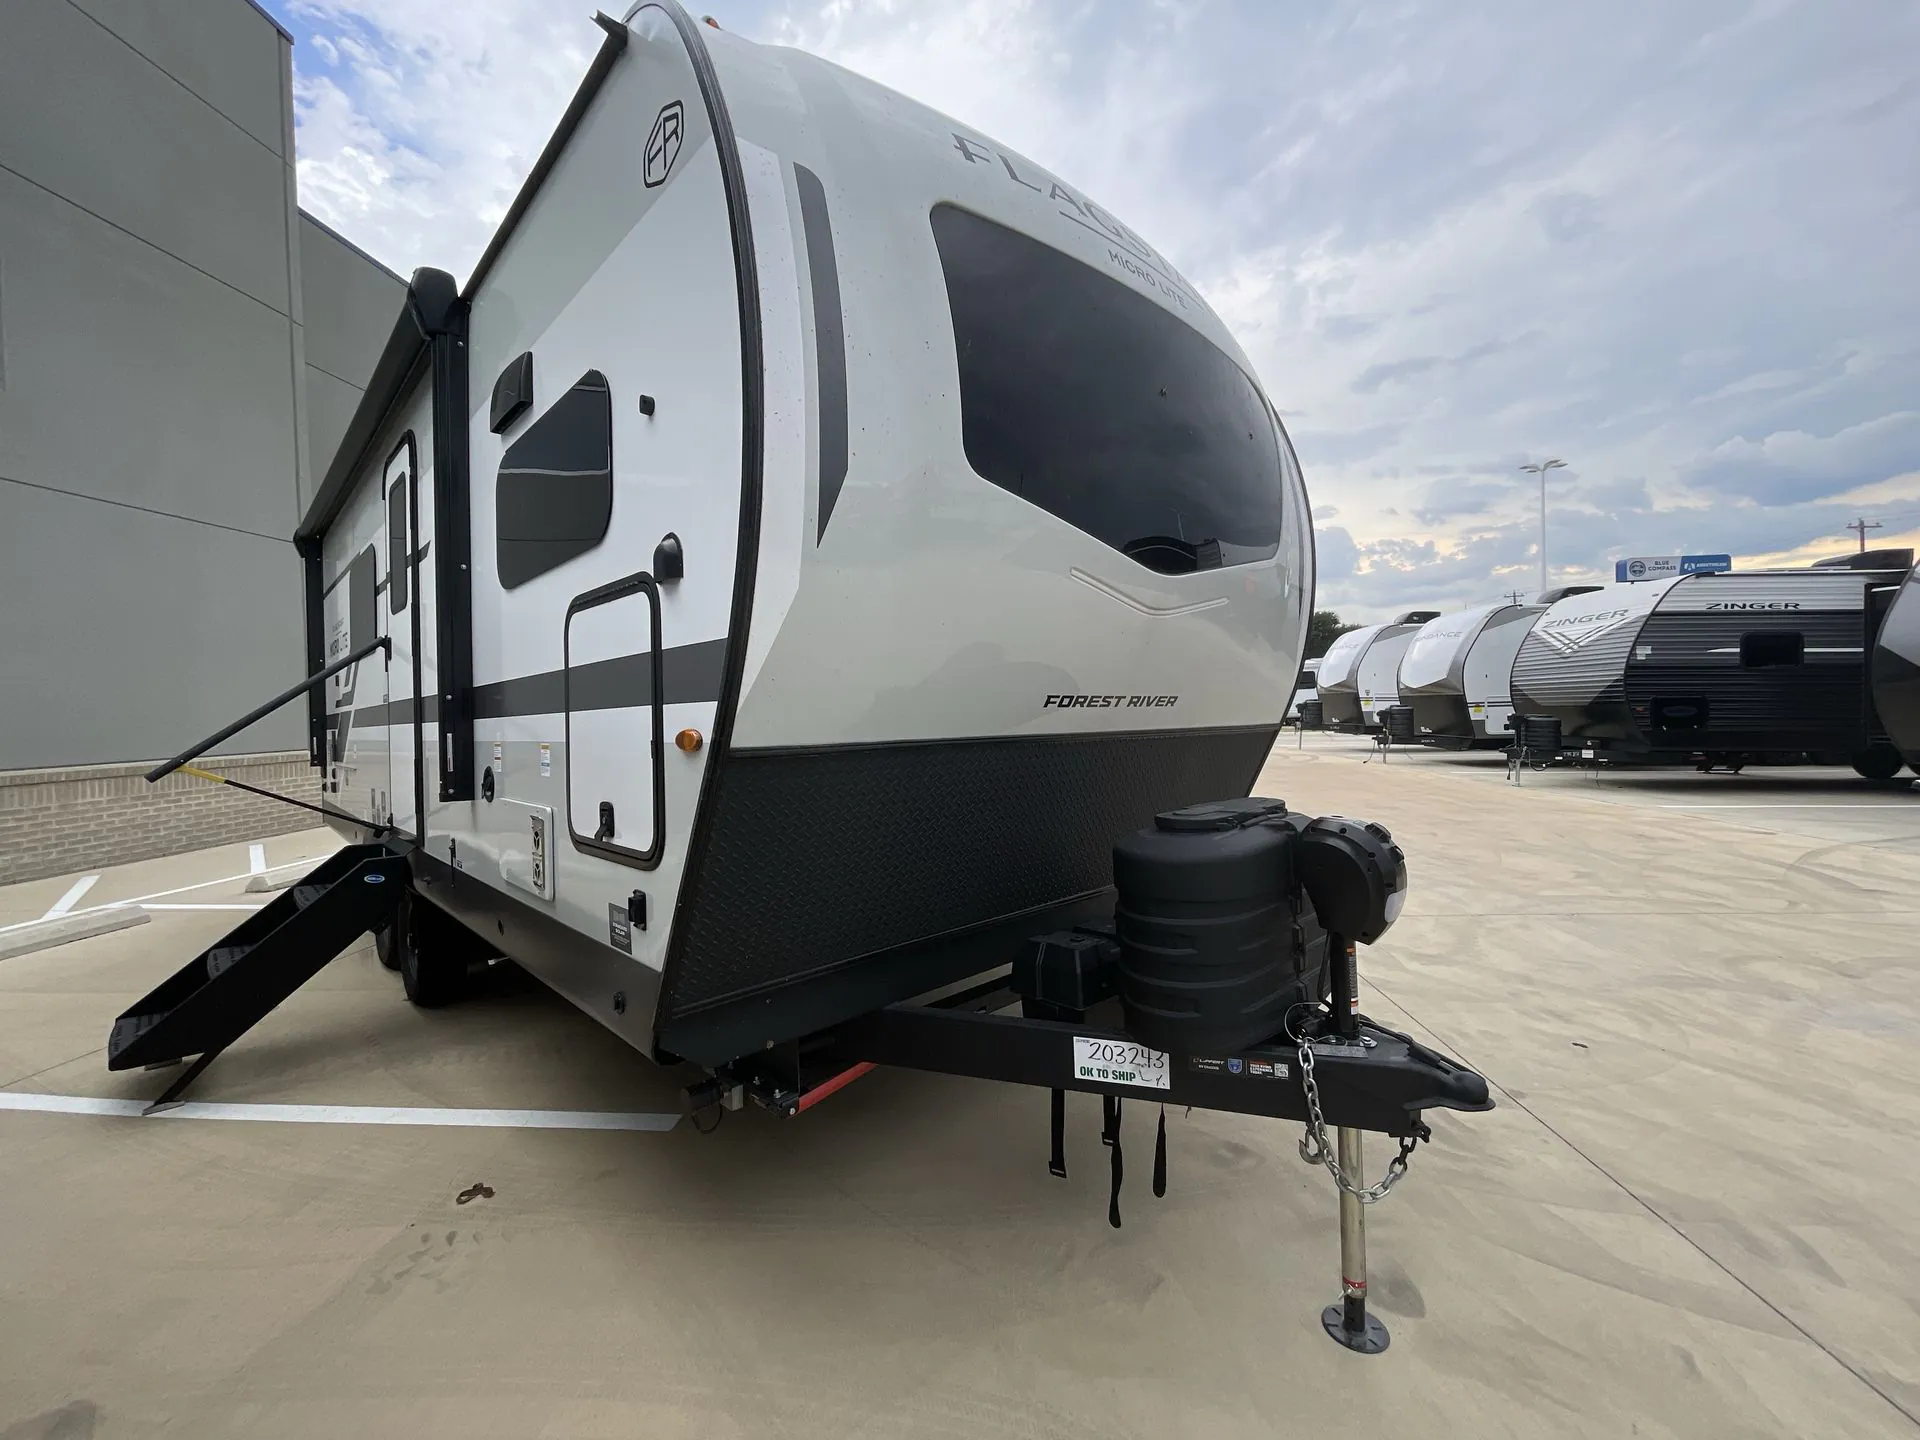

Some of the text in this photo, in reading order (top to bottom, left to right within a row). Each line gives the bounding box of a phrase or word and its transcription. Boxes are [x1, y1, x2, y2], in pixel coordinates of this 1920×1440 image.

[1107, 249, 1188, 311] MICRO LITE
[1542, 609, 1629, 629] ZINGER
[1043, 695, 1178, 708] FOREST RIVER
[1088, 1042, 1165, 1069] 203243
[1079, 1066, 1136, 1082] OK TO SHIP
